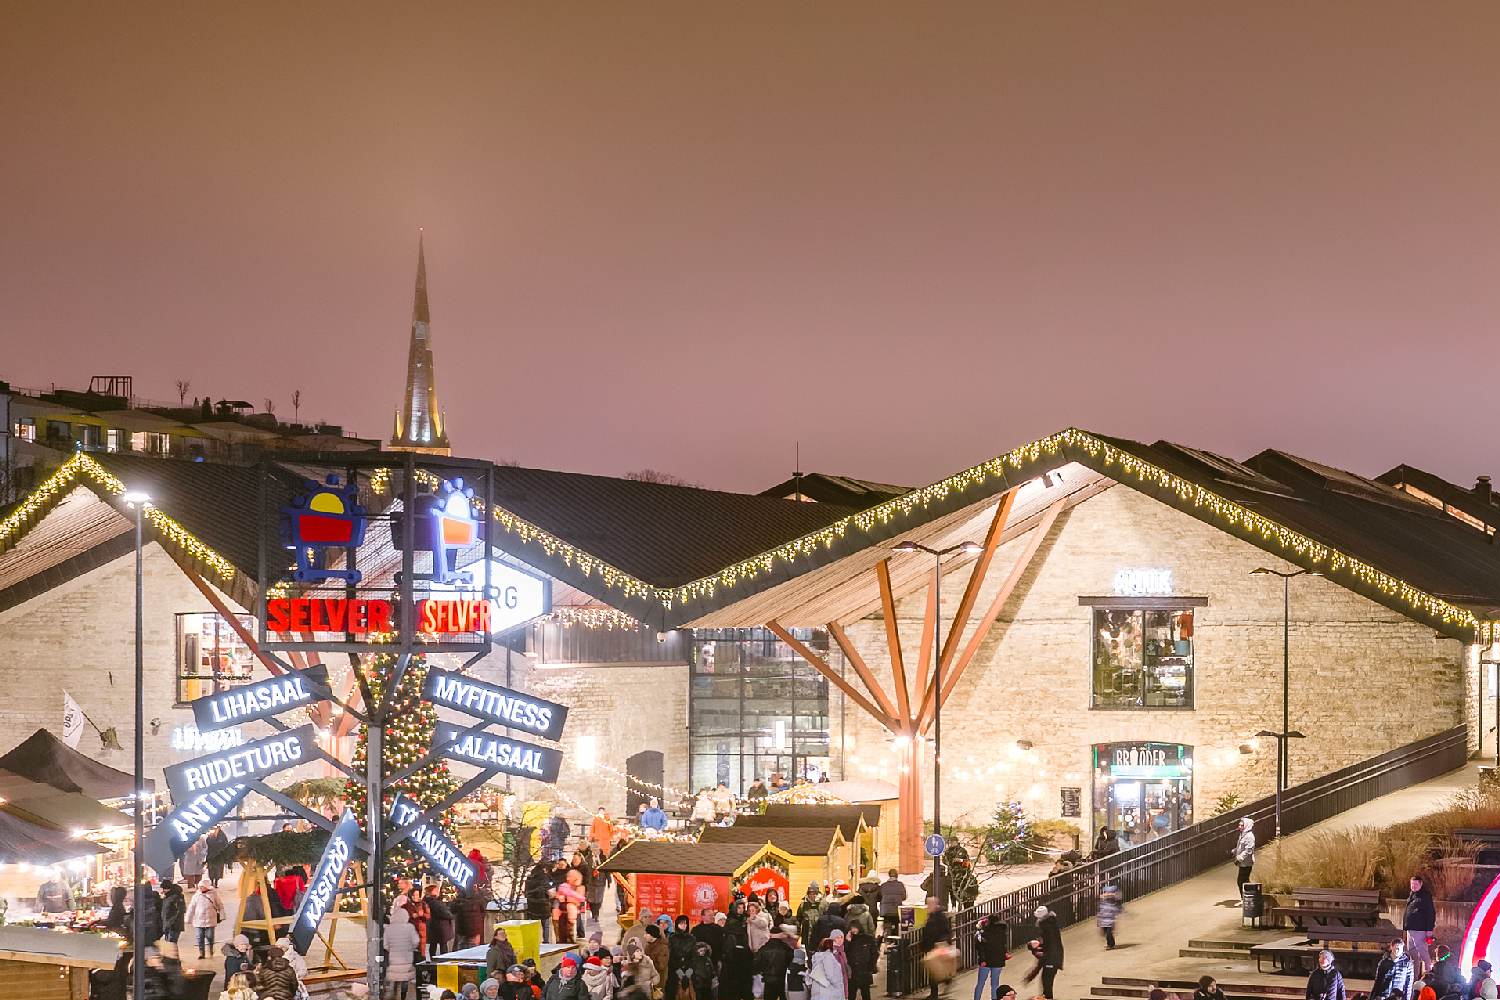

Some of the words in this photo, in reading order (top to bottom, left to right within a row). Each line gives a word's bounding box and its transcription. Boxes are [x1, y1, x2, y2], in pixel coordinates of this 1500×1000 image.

[267, 599, 391, 633] SELVER
[422, 599, 491, 633] SELVER
[213, 677, 310, 723] LIHASAAL
[435, 676, 552, 731] MYFITNESS
[185, 736, 302, 792] RIIDETURG
[306, 836, 349, 928] KÄSITÖÖ
